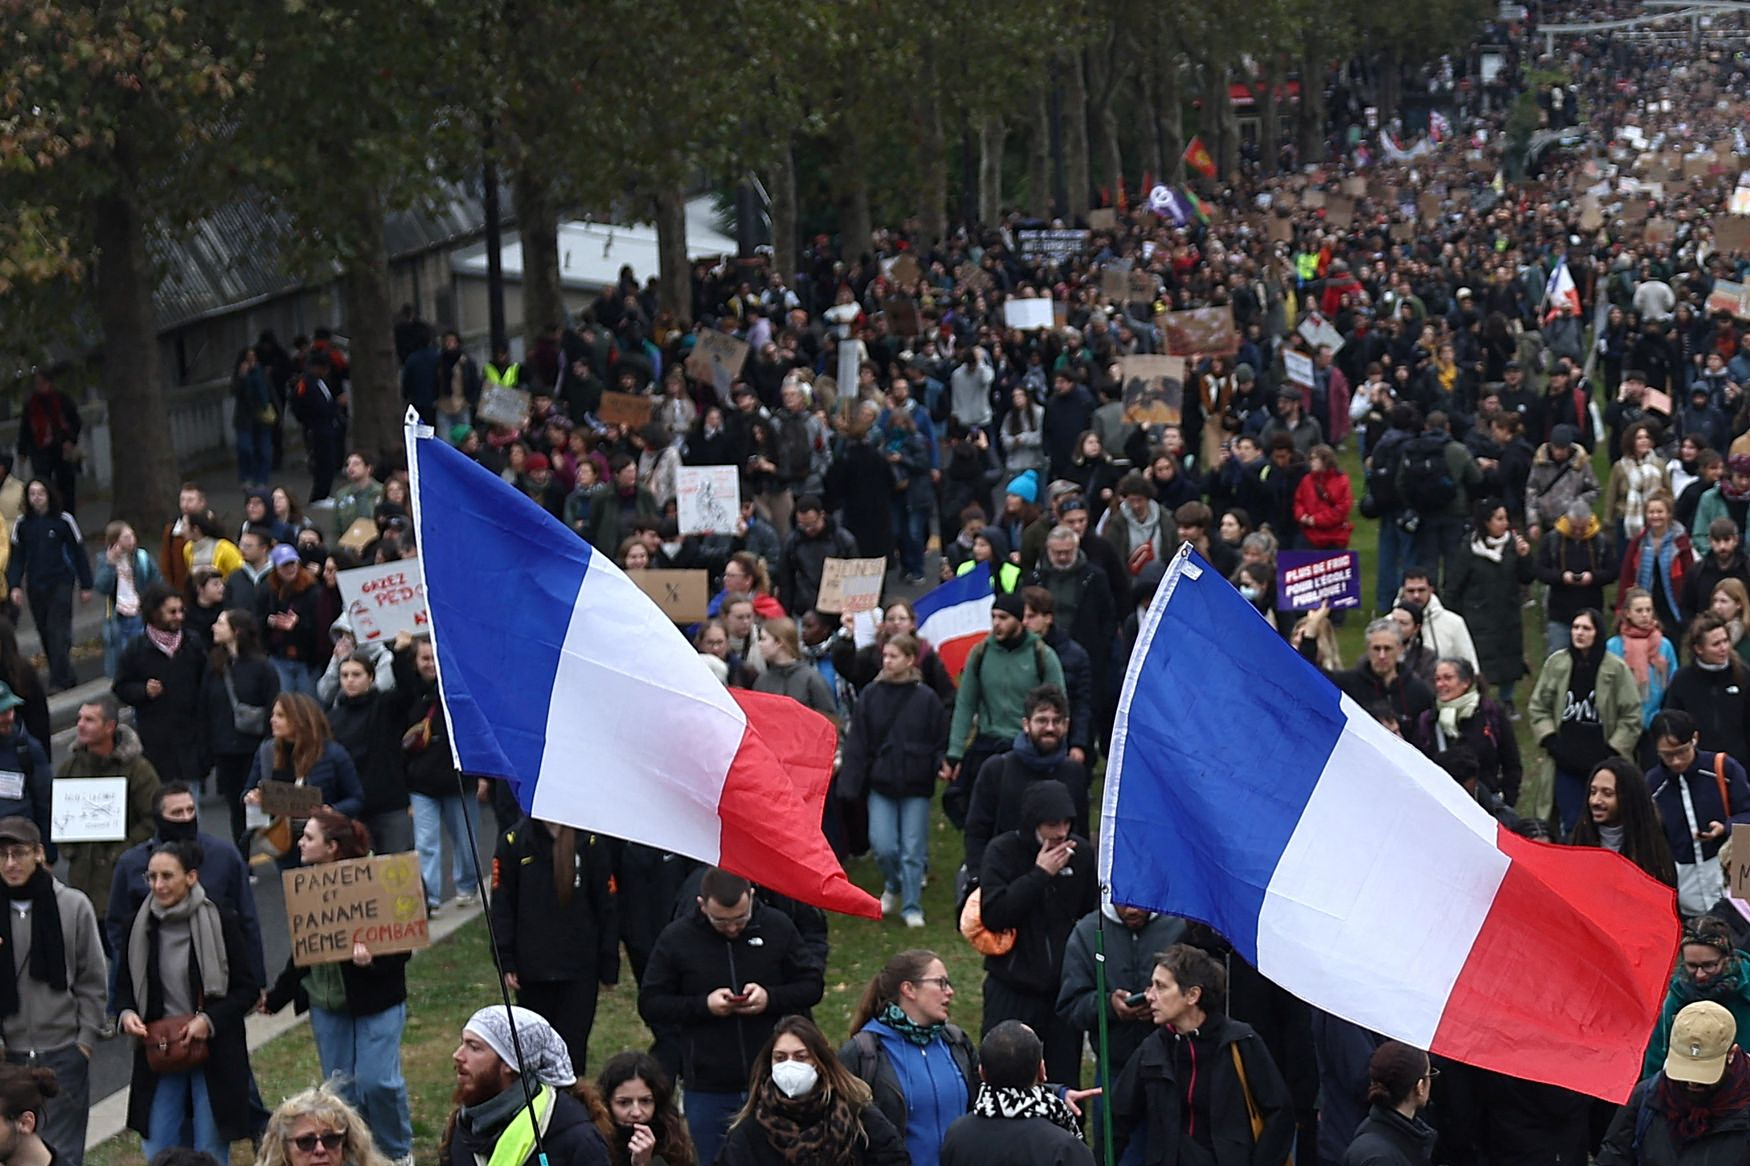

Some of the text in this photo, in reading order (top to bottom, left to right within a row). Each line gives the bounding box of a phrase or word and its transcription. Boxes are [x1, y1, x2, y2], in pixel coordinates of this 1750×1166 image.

[294, 864, 372, 894] PANEM
[323, 889, 338, 903] ET
[293, 899, 377, 933] PANAME
[352, 920, 426, 943] COMBAT
